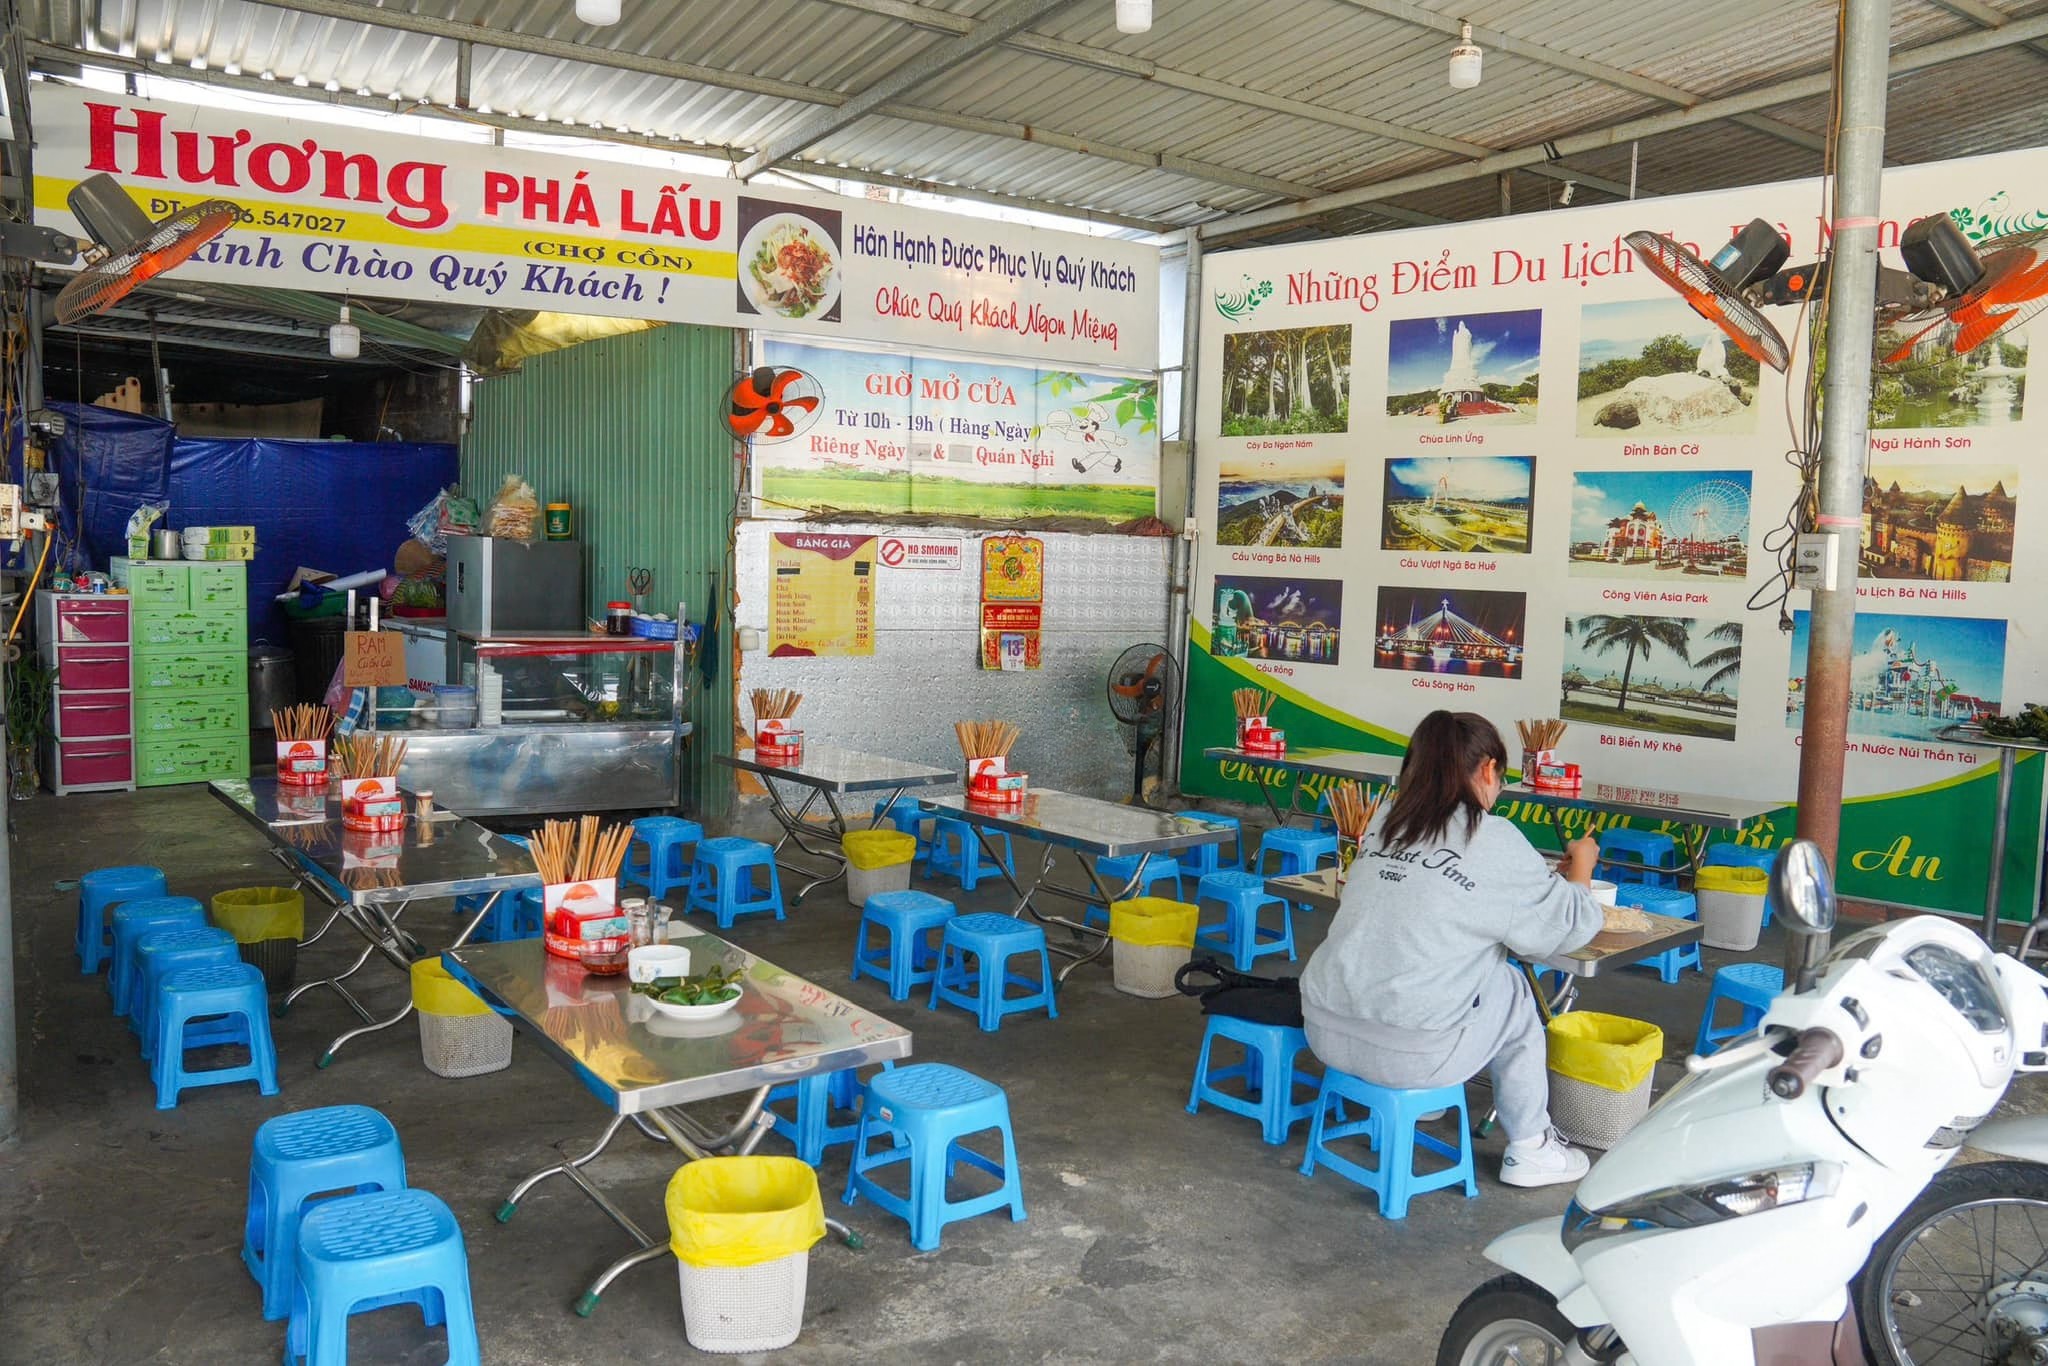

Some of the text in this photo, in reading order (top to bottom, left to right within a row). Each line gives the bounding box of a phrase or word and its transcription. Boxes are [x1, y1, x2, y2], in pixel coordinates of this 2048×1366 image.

[84, 101, 449, 229] Hương
[485, 170, 721, 241] PHÁ LẤU
[523, 240, 694, 271] (CHỢ CỒN)
[853, 224, 1136, 292] Hân Hạnh Được Phục Vụ Quý Khách
[302, 241, 414, 280] Chào
[429, 254, 508, 294] Quý
[521, 263, 644, 302] Khách
[1286, 269, 1379, 313] Những
[1391, 248, 1477, 295] Điểm
[1491, 249, 1547, 286] Du
[1561, 234, 1634, 287] Lịch
[875, 286, 1119, 350] Chúc Quý Khách Ngon Miệng
[865, 372, 1017, 406] GIỜ MỞ CỬA
[835, 409, 858, 427] Từ
[863, 411, 891, 429] 10h
[907, 415, 934, 432] 19h
[1419, 434, 1443, 444] Chùa
[1445, 434, 1463, 443] Linh
[1653, 444, 1676, 455] Bàn
[1680, 443, 1700, 455] Cờ
[1871, 436, 1972, 452] Ngũ Hành Sơn
[810, 435, 859, 459] Riêng
[865, 439, 906, 463] Ngày
[933, 443, 946, 460] &
[976, 446, 1015, 466] Quán
[796, 536, 829, 548] BẢNG
[908, 544, 958, 556] NO SMOKING
[1303, 554, 1321, 564] Hills
[1464, 560, 1476, 570] Ba
[1478, 560, 1497, 571] Huế
[1602, 589, 1709, 603] Công Viên Asia Park
[1870, 586, 1895, 599] Lịch
[1942, 588, 1967, 600] Hills
[357, 634, 386, 655] RAM
[1008, 639, 1020, 657] 13
[1457, 681, 1475, 691] Hàn
[1662, 742, 1683, 752] Khê
[1862, 742, 1895, 756] Nước
[1899, 745, 1920, 758] Núi
[1924, 748, 1954, 762] Thần
[1957, 752, 1977, 764] Tài
[1852, 835, 1944, 881] An
[1422, 848, 1476, 892] Time
